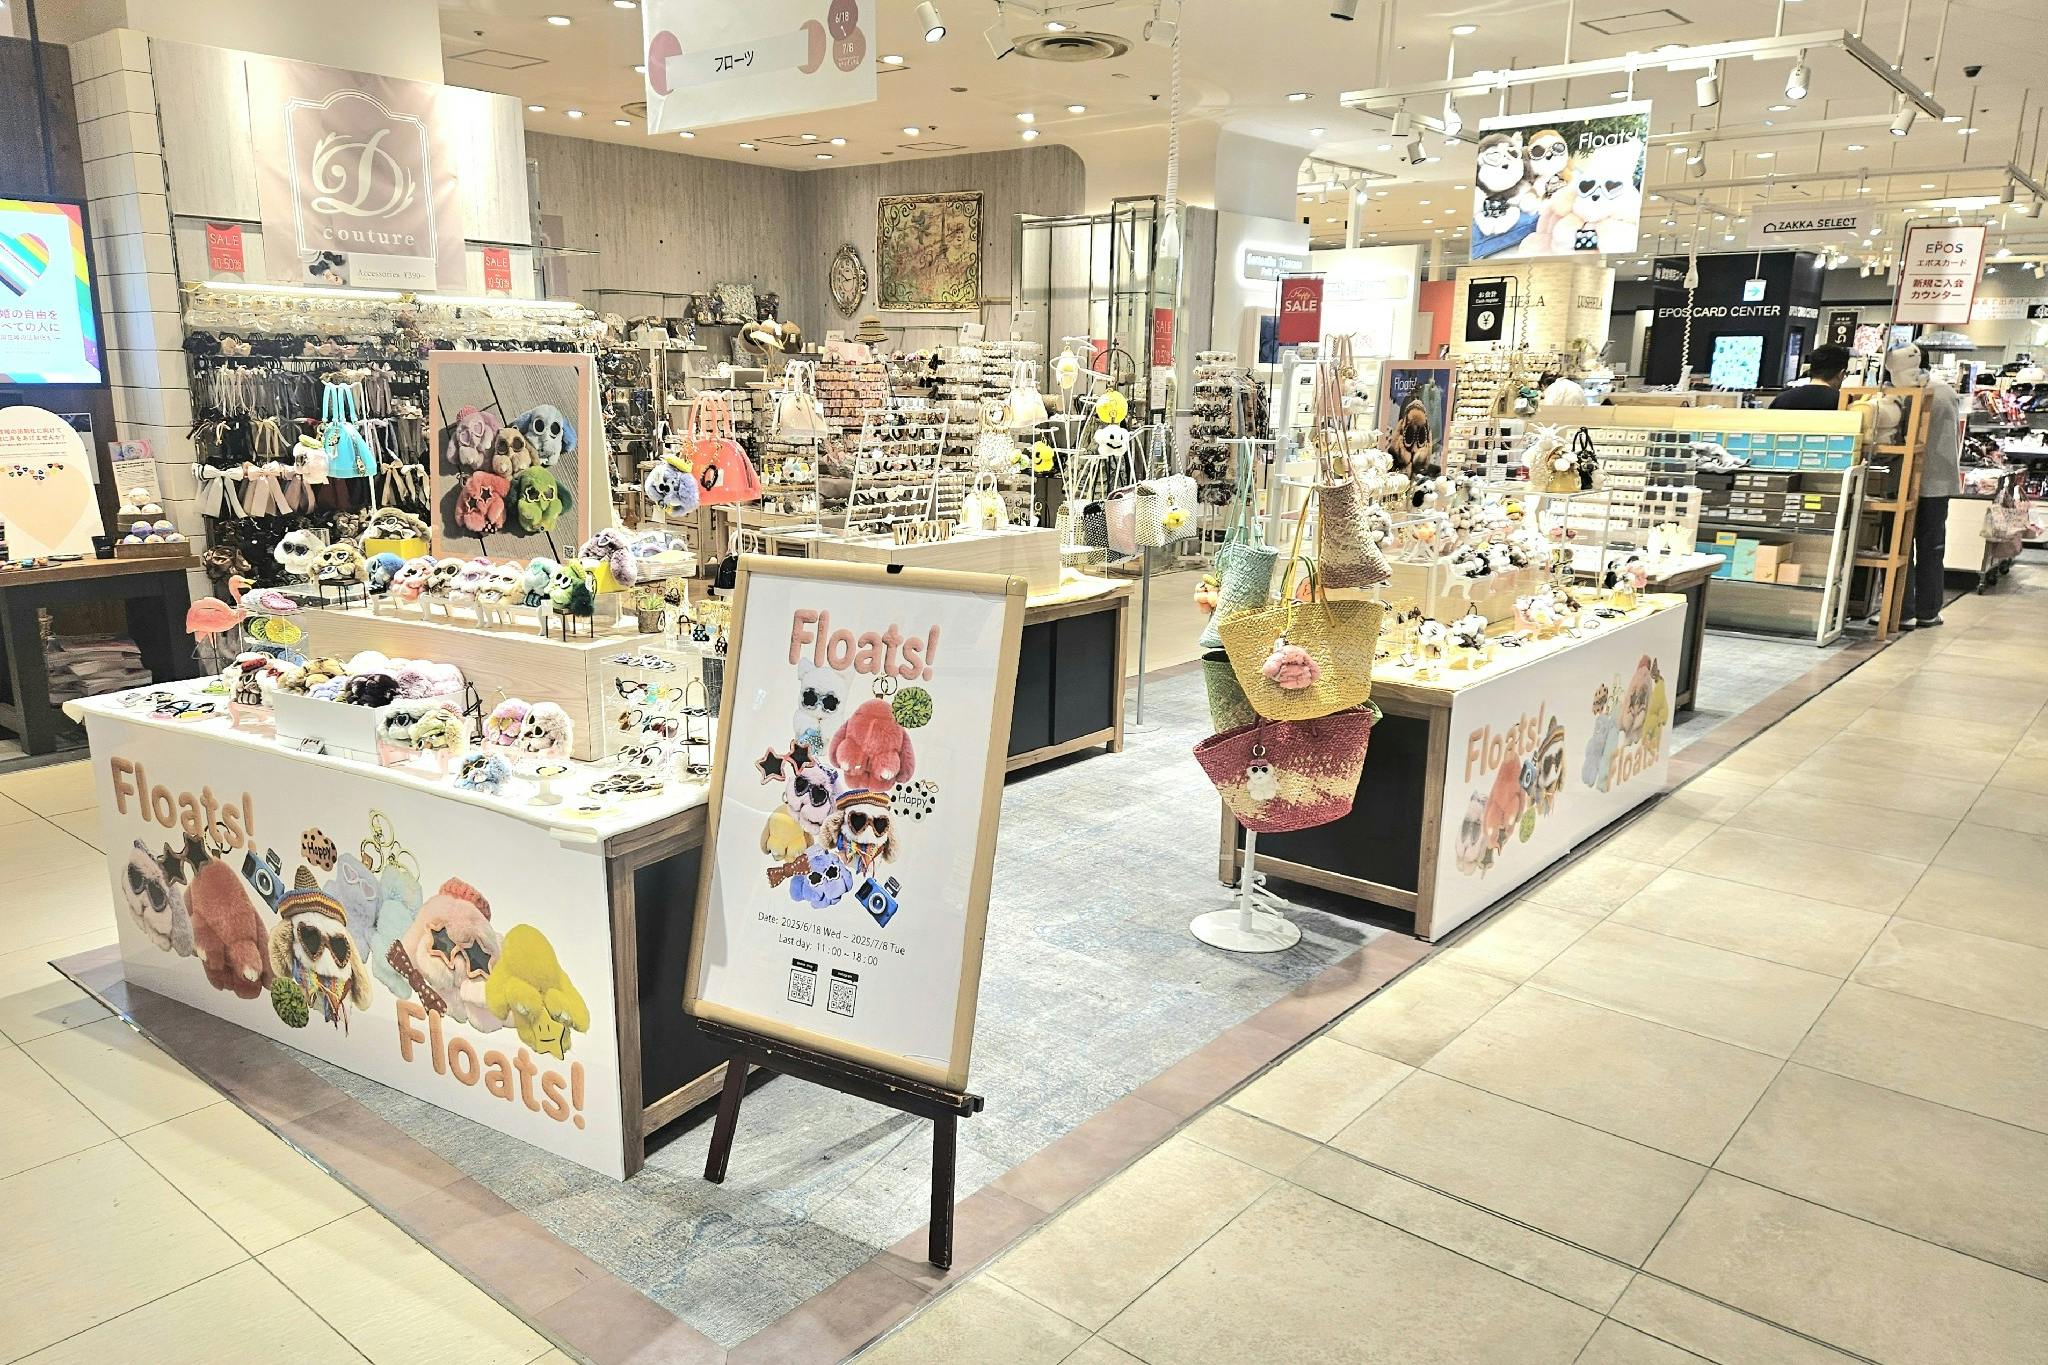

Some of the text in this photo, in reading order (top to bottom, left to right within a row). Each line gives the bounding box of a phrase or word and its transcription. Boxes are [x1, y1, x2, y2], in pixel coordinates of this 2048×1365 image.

[835, 11, 850, 23] 6/18
[842, 42, 854, 54] 7/8
[714, 50, 755, 73] フローツ
[1778, 217, 1857, 230] ZAKKA SELECT
[210, 232, 239, 246] SALE
[323, 228, 416, 246] couture
[1926, 241, 1964, 254] EPOS
[485, 256, 508, 267] SALE
[1917, 259, 1967, 268] エポスカード
[359, 269, 400, 278] Accessories
[1912, 279, 1965, 288] 新規ご入会
[1911, 291, 1962, 299] カウンター
[1285, 301, 1318, 312] SALE
[1659, 307, 1692, 318] EPOS
[1693, 306, 1727, 317] CARD
[1731, 305, 1781, 317] CENTER
[1156, 320, 1172, 333] SALE
[1394, 376, 1418, 391] Floats!
[788, 608, 941, 682] Floats!
[1464, 700, 1546, 784] Floats!
[110, 756, 257, 855] Floats!
[898, 791, 928, 809] Happy
[306, 841, 332, 861] Happy
[758, 911, 779, 925] Date:
[781, 917, 821, 935] 2025/6/18
[823, 926, 842, 940] Wed
[851, 933, 888, 951] 2025/7/8
[890, 943, 906, 956] Tue
[778, 933, 794, 946] Last
[795, 938, 812, 951] day:
[396, 999, 586, 1130] Floats!
